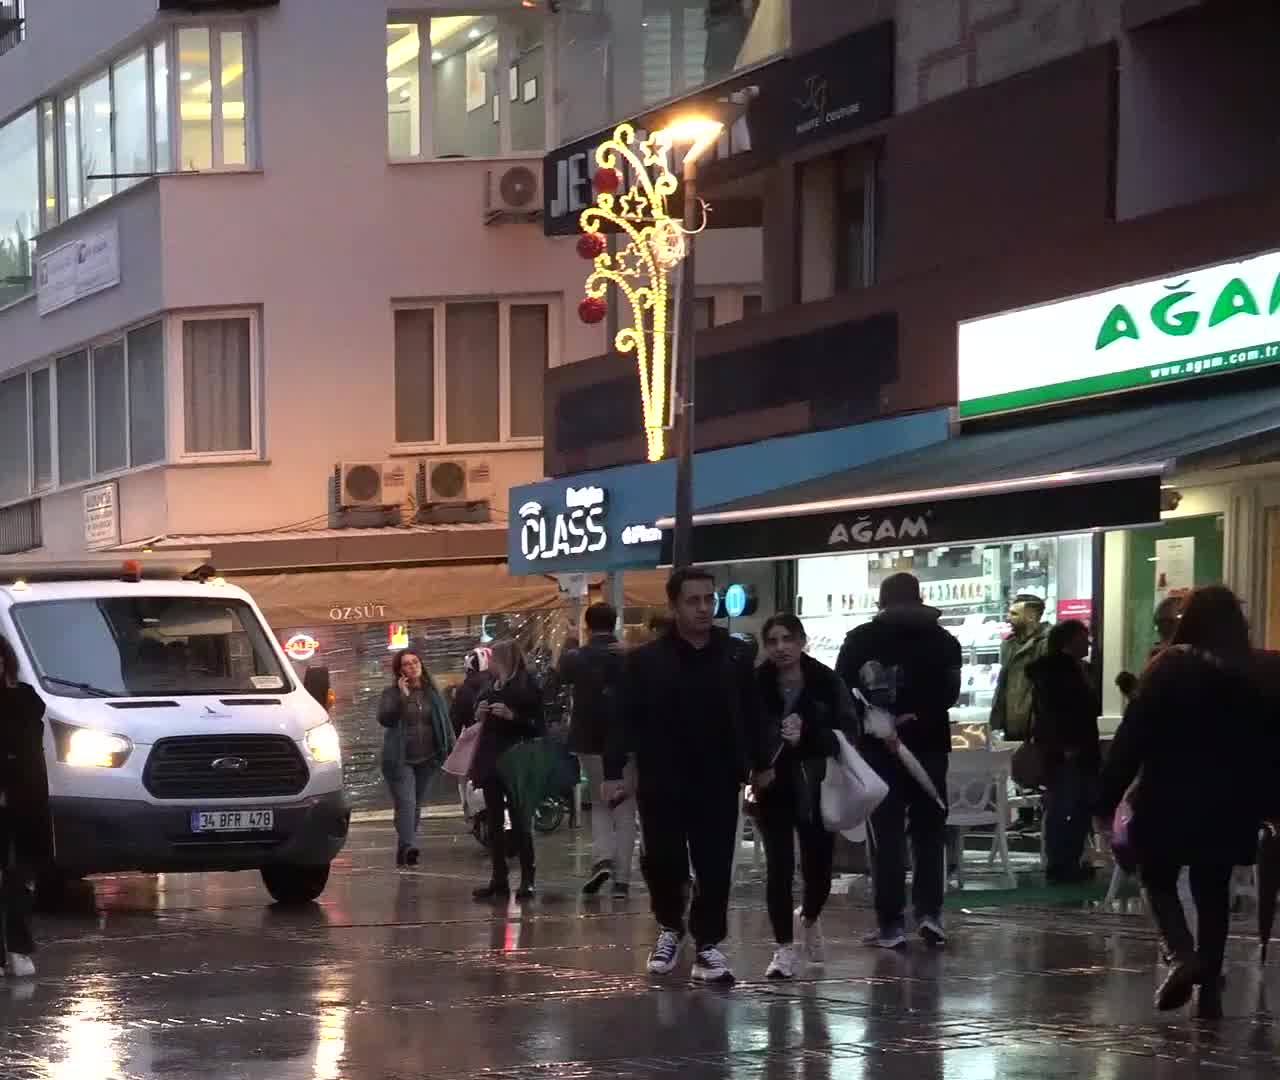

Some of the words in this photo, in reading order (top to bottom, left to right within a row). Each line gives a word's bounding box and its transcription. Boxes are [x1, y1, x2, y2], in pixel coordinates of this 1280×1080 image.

[521, 507, 607, 560] CLASS
[828, 513, 929, 545] AĞAM
[329, 602, 386, 620] ÖZSÜT
[200, 814, 215, 828] 34
[249, 812, 271, 827] 478
